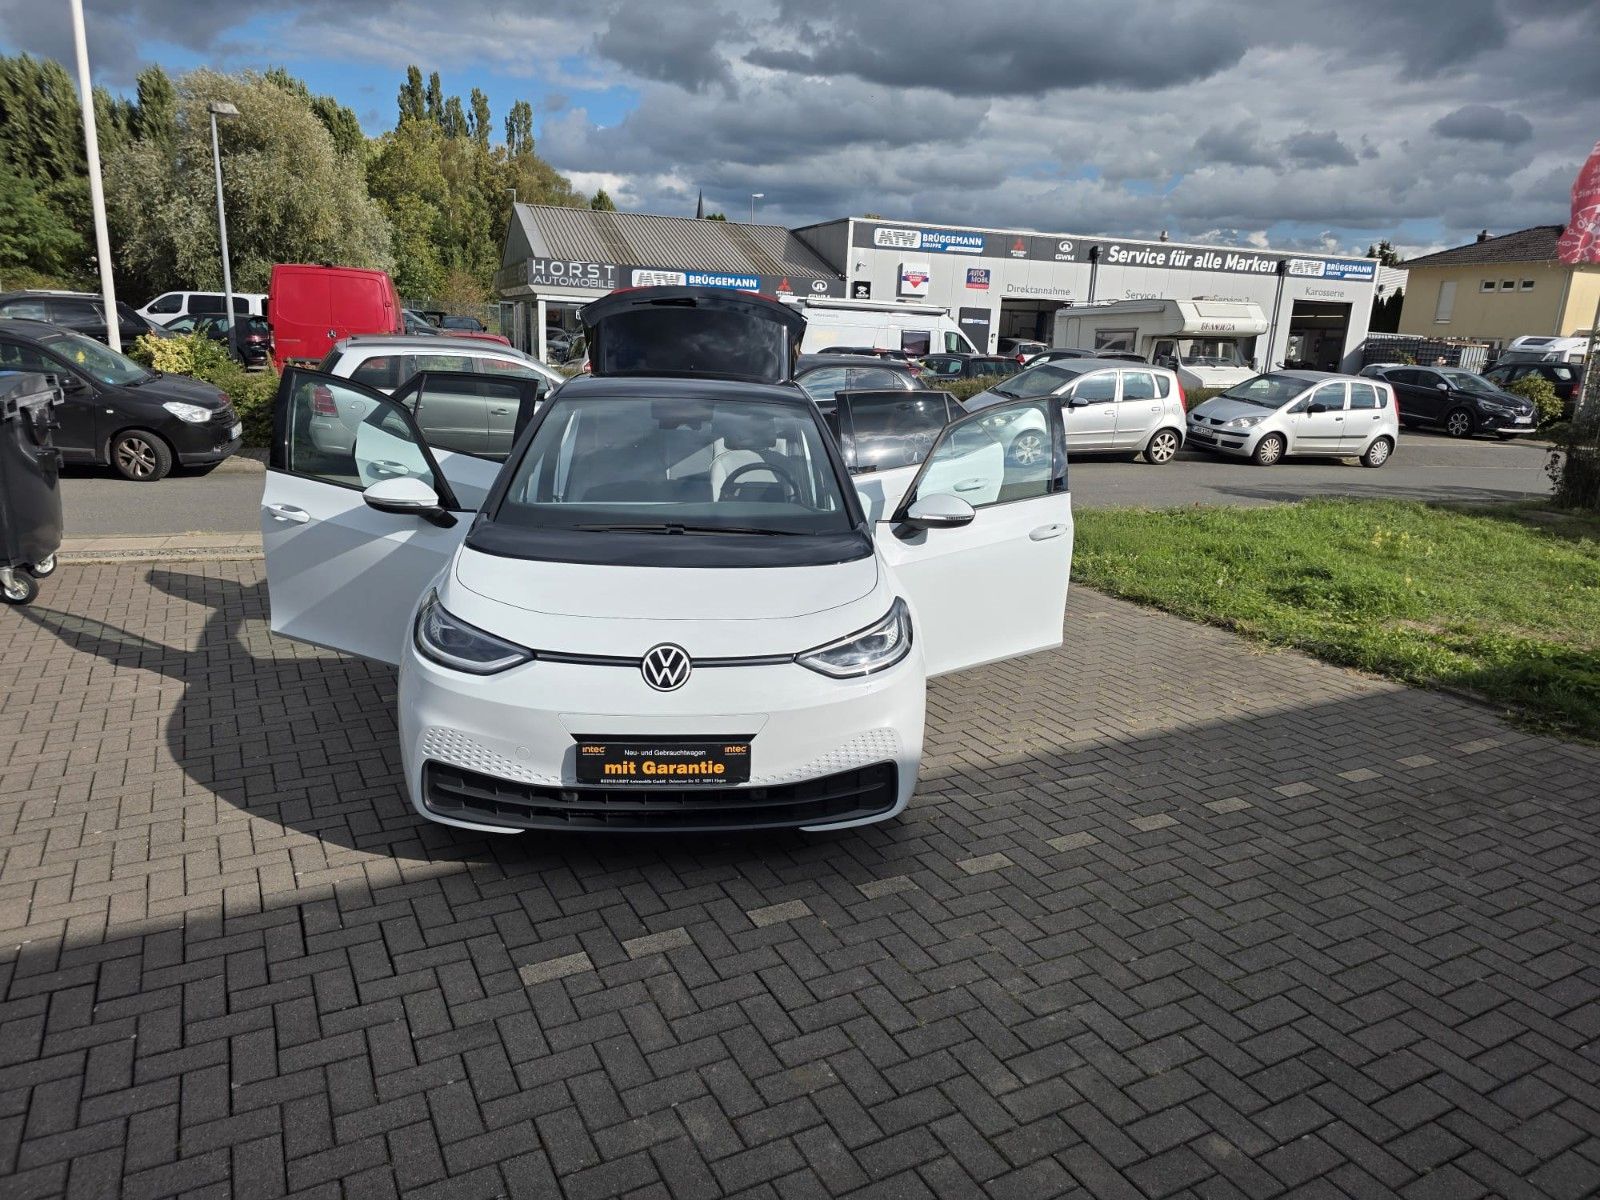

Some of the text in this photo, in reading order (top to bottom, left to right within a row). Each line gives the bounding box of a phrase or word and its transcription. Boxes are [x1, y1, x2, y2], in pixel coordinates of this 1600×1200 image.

[922, 233, 982, 246] BRÜGGEMANN
[1055, 253, 1074, 261] GWM
[1108, 245, 1277, 273] Service für alle Marken
[532, 259, 615, 279] HORST
[1326, 263, 1372, 273] BRÜGGEMANN
[533, 275, 615, 288] AUTOMOBILE
[688, 274, 757, 288] BRÜGGEMANN
[1006, 283, 1071, 296] Direktannahme
[1124, 289, 1157, 300] Service
[1305, 286, 1345, 298] Karosserie
[654, 749, 706, 757] Gebrauchtwagen
[604, 761, 725, 774] mit Garantie
